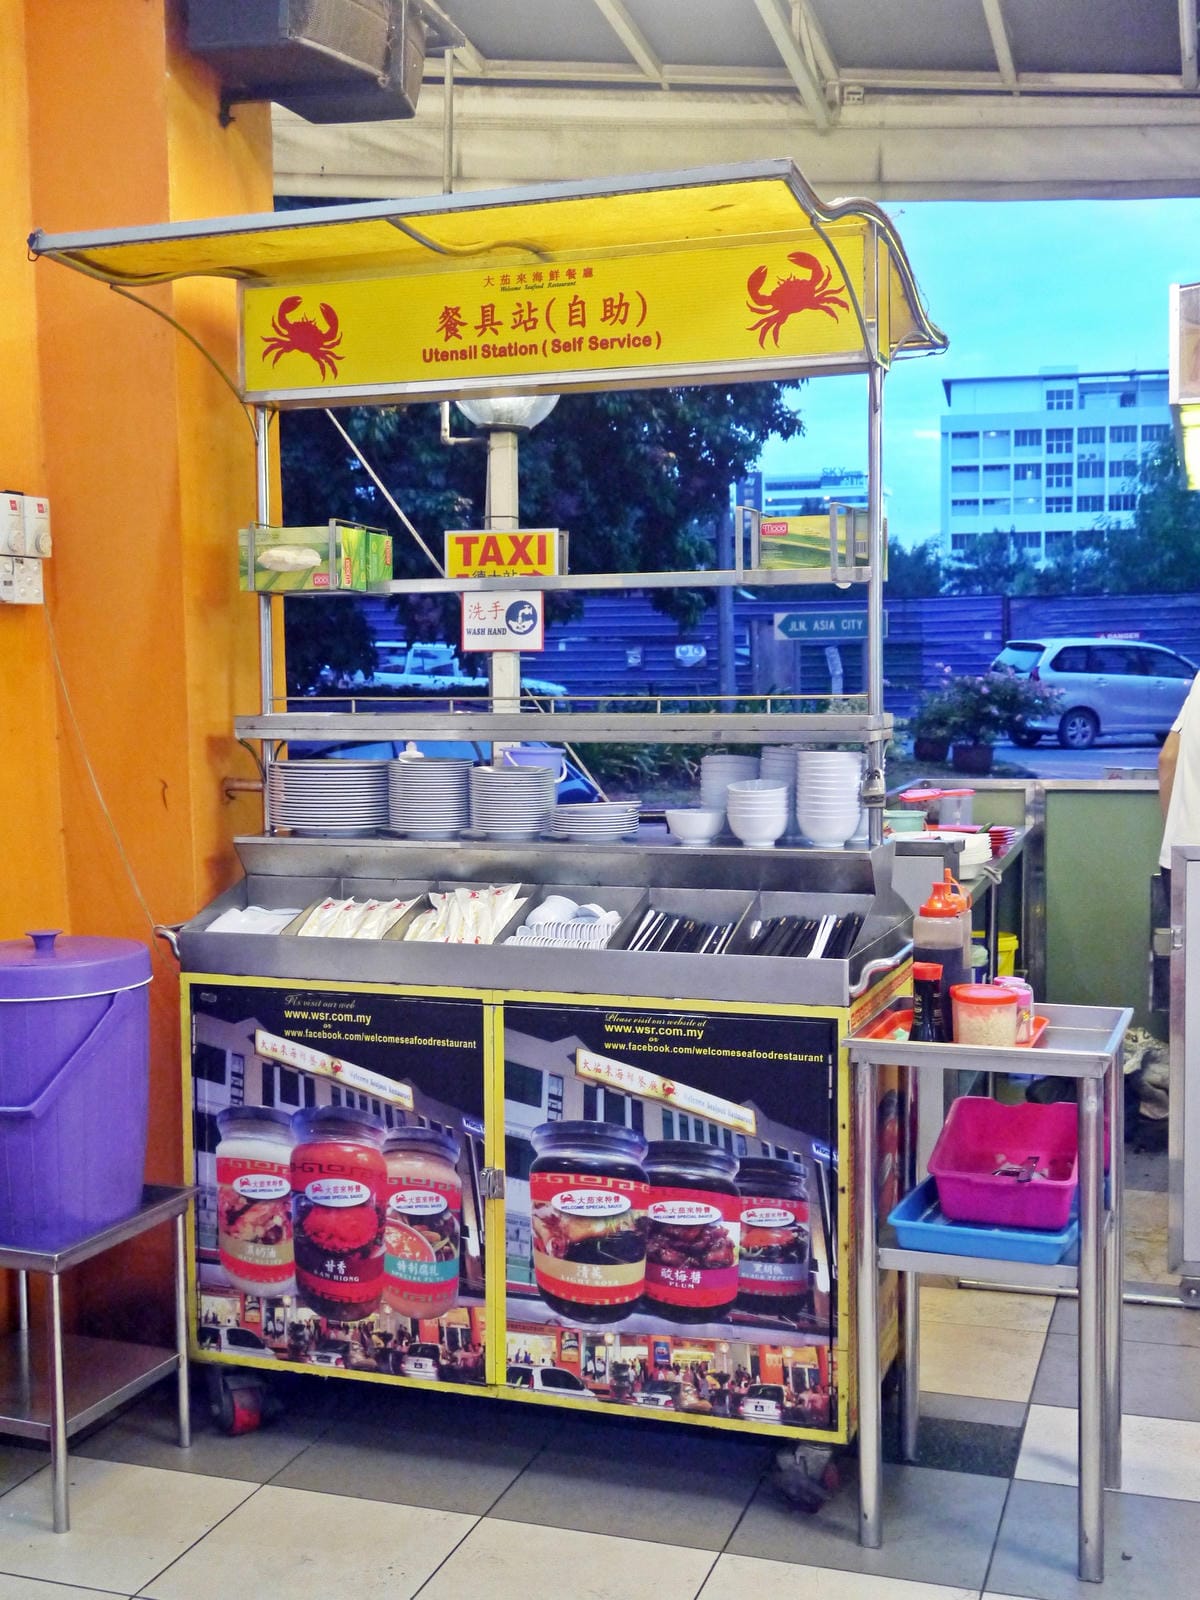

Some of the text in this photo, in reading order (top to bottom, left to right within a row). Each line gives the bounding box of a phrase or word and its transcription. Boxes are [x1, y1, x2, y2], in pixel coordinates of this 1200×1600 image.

[422, 345, 477, 363] Utensil
[481, 341, 538, 359] Station
[455, 535, 547, 567] TAXI
[469, 601, 504, 621] 洗手
[813, 620, 835, 630] ASIA
[841, 619, 863, 630] CITY
[284, 1010, 371, 1025] www.wsr.com.my
[284, 1029, 476, 1049] www.facebook.com/welcomeseafoodrestaurant
[604, 1024, 704, 1039] www.wsr.com.my
[604, 1042, 824, 1062] www.facebook.com/welcomeseafoodrestaurant
[325, 1259, 347, 1275] 甘香
